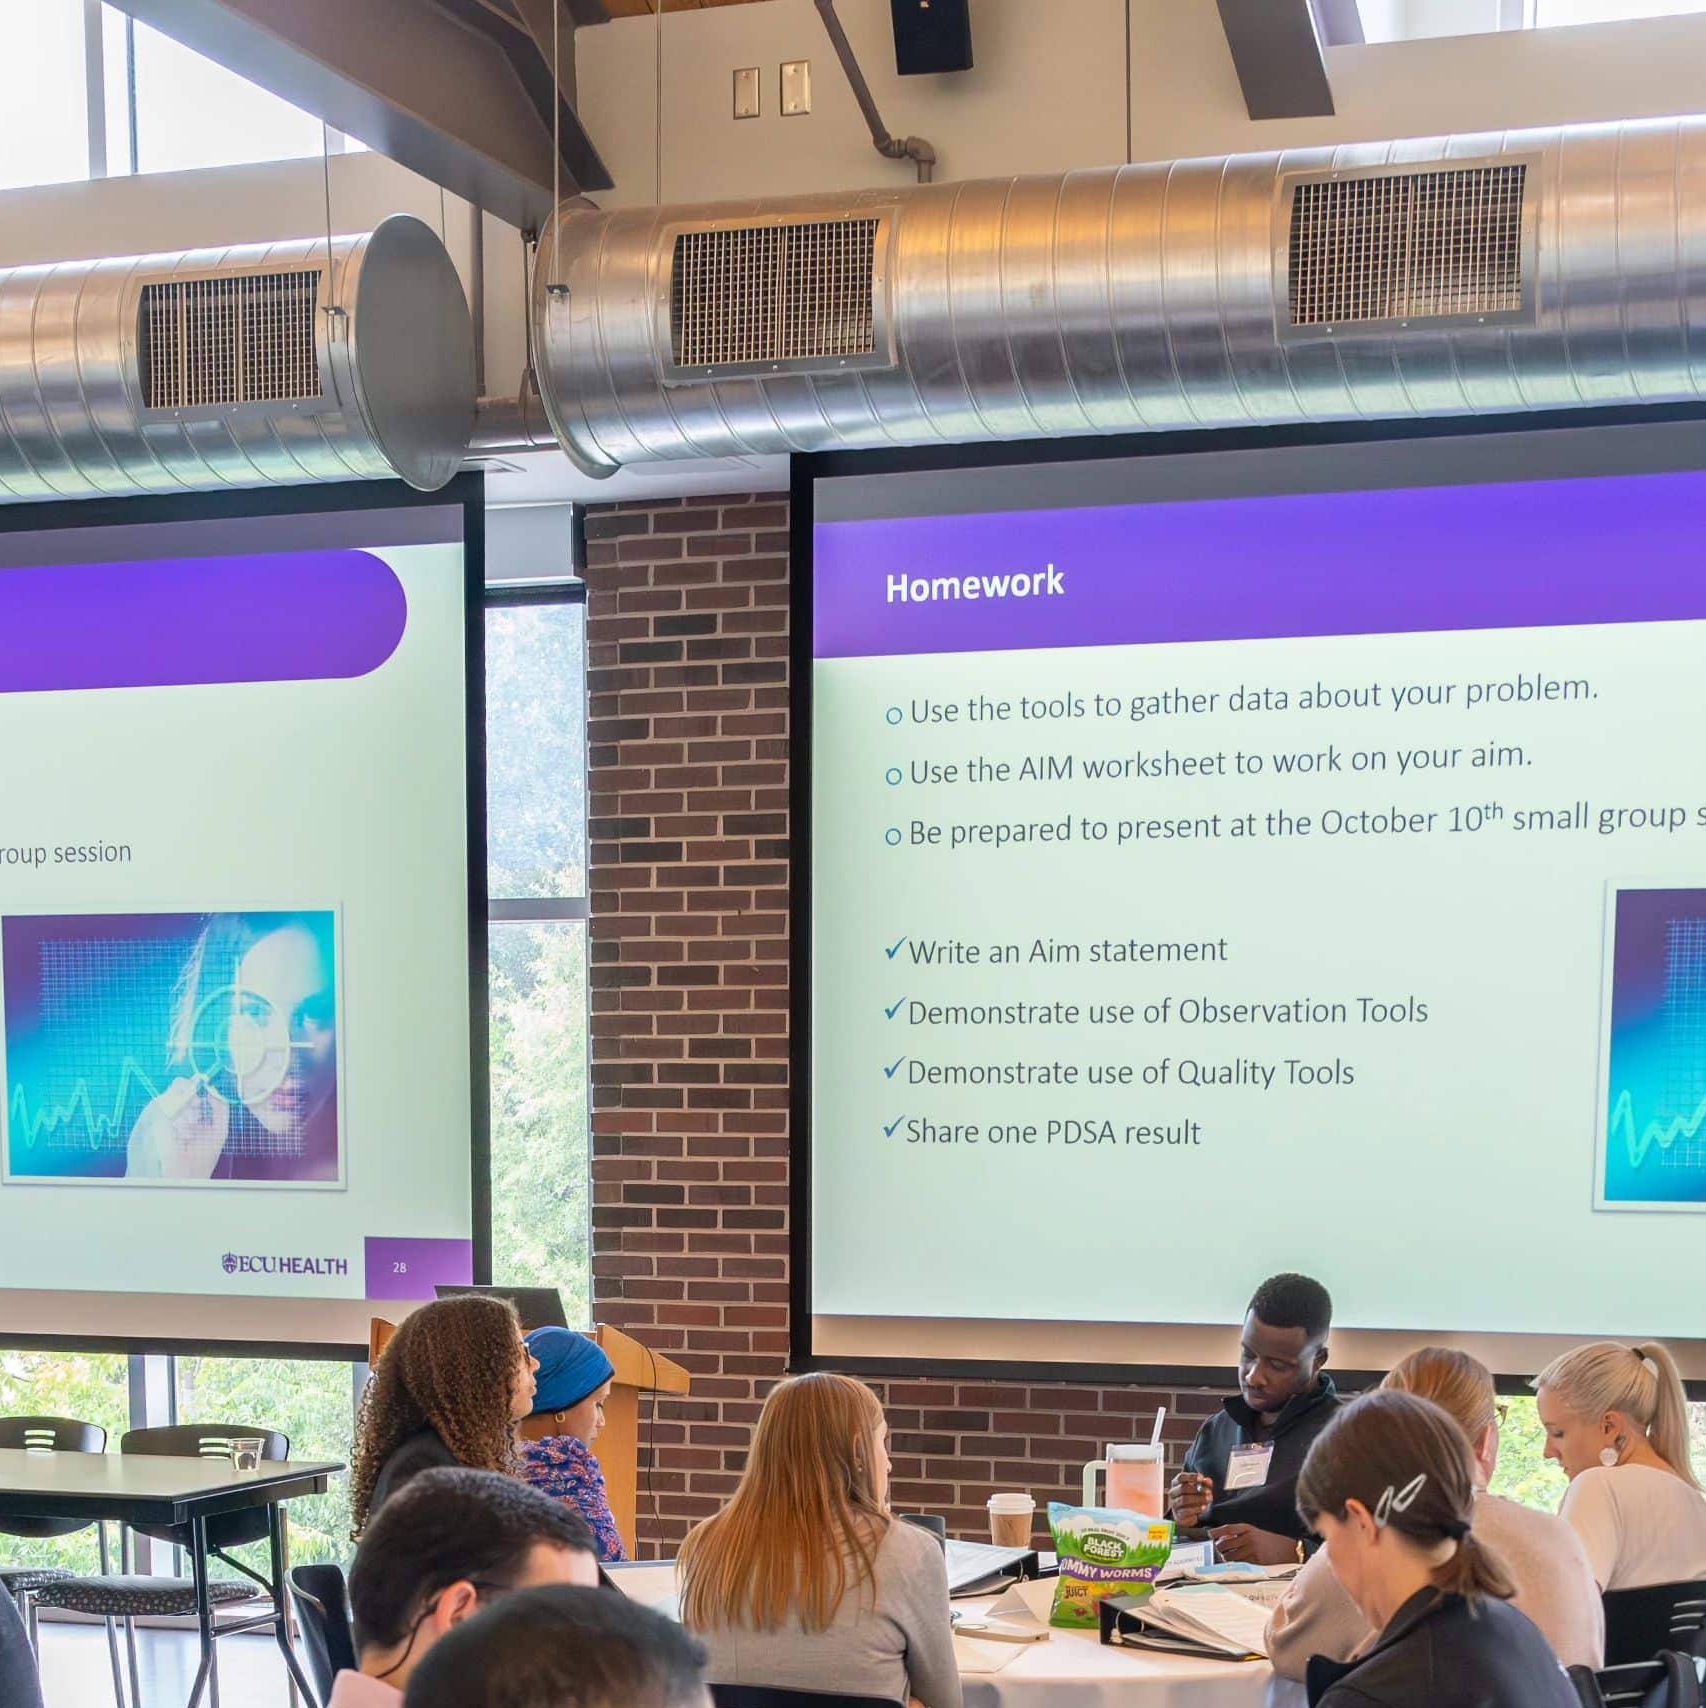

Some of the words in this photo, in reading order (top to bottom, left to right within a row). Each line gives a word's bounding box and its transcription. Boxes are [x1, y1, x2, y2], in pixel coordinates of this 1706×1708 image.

[887, 563, 1065, 603] Homework
[911, 699, 959, 724] Use
[967, 695, 1011, 722] the
[1020, 690, 1086, 720] tools
[1094, 693, 1122, 717] to
[1130, 687, 1220, 722] gather
[1229, 684, 1288, 712] data
[1298, 681, 1382, 710] about
[1391, 684, 1457, 712] your
[1466, 672, 1598, 710] problem.
[911, 759, 958, 785] Use
[966, 756, 1011, 783] the
[1018, 754, 1073, 781] AIM
[1082, 749, 1226, 779] worksheet
[1235, 751, 1263, 775] to
[1272, 744, 1342, 774] work
[1351, 751, 1386, 771] on
[1396, 748, 1462, 776] your
[1471, 740, 1532, 768] aim.
[910, 820, 942, 845] Be
[951, 814, 1071, 849] prepared
[1080, 817, 1108, 841] to
[1117, 814, 1222, 846] present
[1230, 813, 1257, 837] at
[1265, 808, 1312, 837] the
[1321, 805, 1438, 835] October
[1449, 801, 1504, 832] 10th
[1513, 801, 1588, 831] small
[1598, 807, 1686, 835] group
[54, 839, 131, 864] session
[908, 939, 980, 965] Write
[989, 945, 1020, 964] an
[1028, 938, 1080, 963] Aim
[1089, 938, 1228, 963] statement
[909, 1000, 1080, 1025] Demonstrate
[1089, 1005, 1135, 1024] use
[1143, 996, 1172, 1024] of
[1179, 996, 1347, 1024] Observation
[1356, 995, 1428, 1023] Tools
[909, 1060, 1079, 1085] Demonstrate
[1088, 1065, 1133, 1085] use
[1142, 1057, 1171, 1085] of
[1178, 1058, 1276, 1091] Quality
[1284, 1057, 1355, 1085] Tools
[906, 1117, 979, 1144] Share
[988, 1125, 1037, 1144] one
[1047, 1120, 1117, 1145] PDSA
[1125, 1118, 1202, 1145] result
[238, 1255, 276, 1273] ECU
[279, 1257, 348, 1275] HEALTH
[393, 1262, 407, 1274] 28
[1083, 1543, 1124, 1558] FOREST
[1087, 1536, 1122, 1550] BLACK
[1100, 1566, 1152, 1579] WORMS
